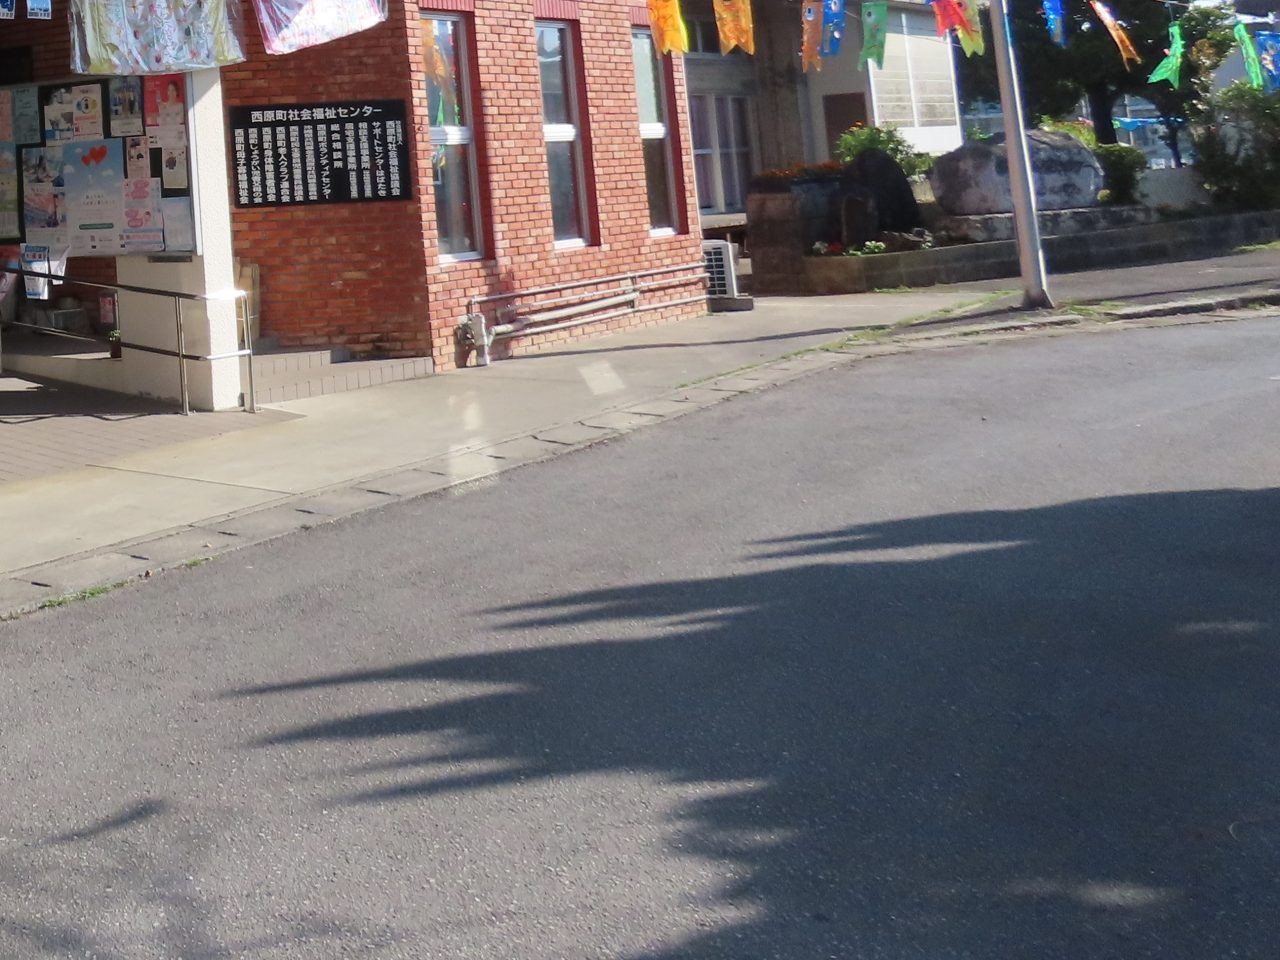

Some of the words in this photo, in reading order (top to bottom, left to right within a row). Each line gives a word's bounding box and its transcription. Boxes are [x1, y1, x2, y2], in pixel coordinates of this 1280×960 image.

[251, 106, 383, 123] 西原町社会福祉センター
[317, 123, 331, 199] 西原町ボランティアセンター
[330, 123, 343, 169] 総合相談所
[385, 120, 400, 197] 西原町社会福祉協議会
